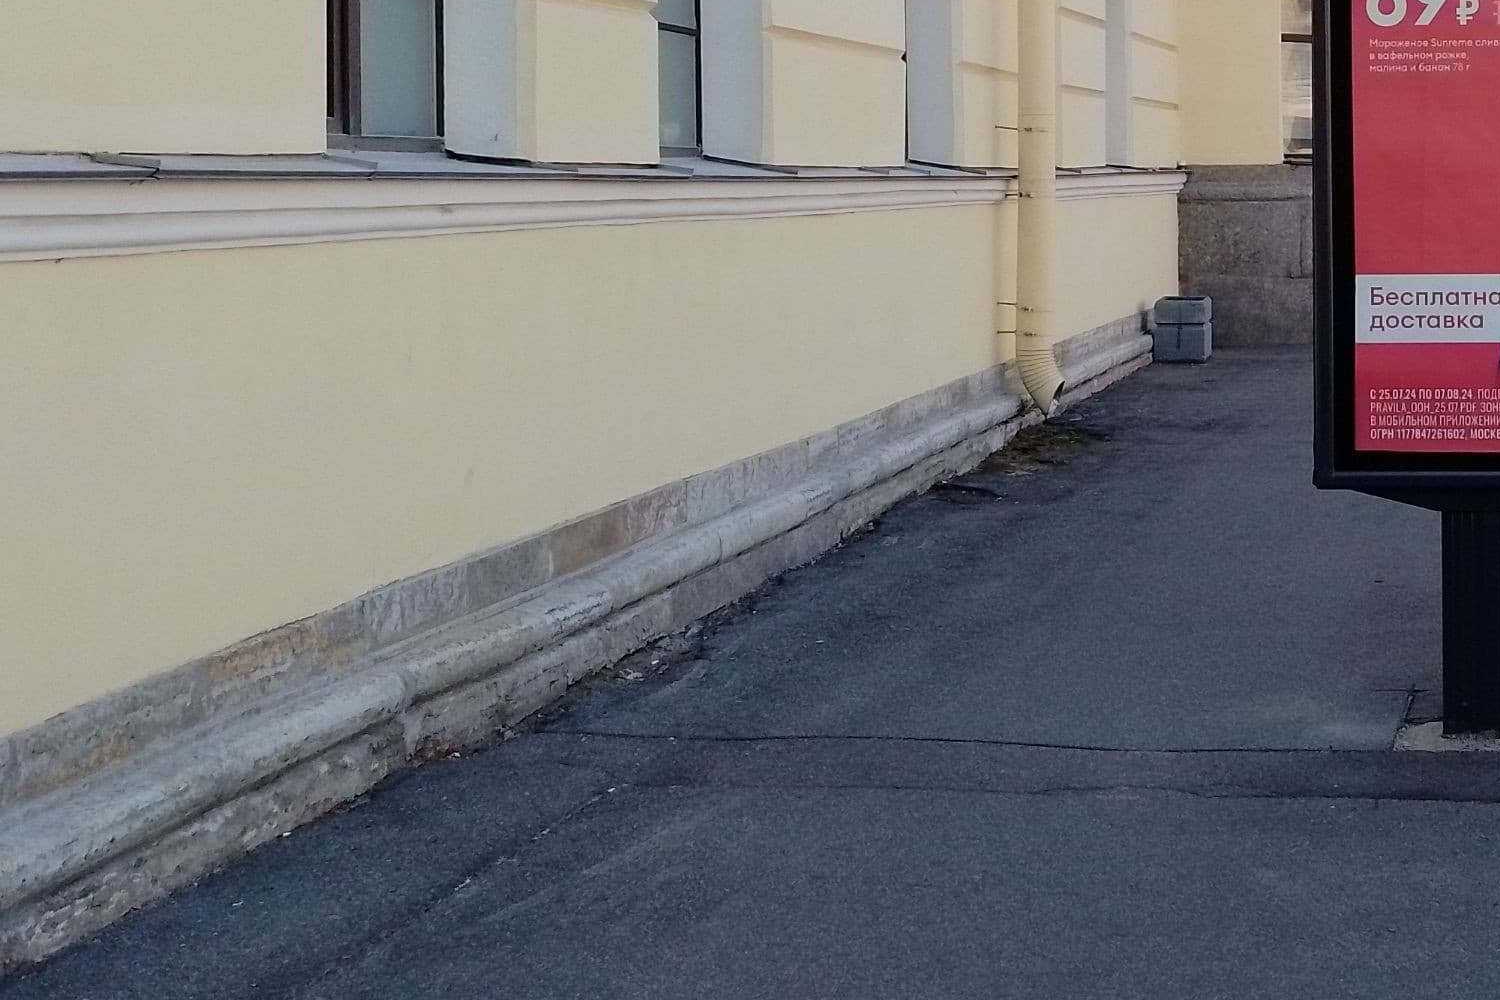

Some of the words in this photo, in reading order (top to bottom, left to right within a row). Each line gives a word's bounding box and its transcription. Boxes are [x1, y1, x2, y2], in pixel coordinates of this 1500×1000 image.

[1369, 38, 1428, 49] Мороженое
[1378, 51, 1433, 61] вафельном
[1419, 63, 1450, 72] банан
[1370, 314, 1484, 332] доставка
[1369, 388, 1377, 400] С
[1379, 388, 1417, 400] 25.07.24
[1419, 388, 1432, 400] ПО
[1370, 414, 1377, 426] В
[1379, 414, 1438, 426] МОБИЛЬНОМ
[1370, 428, 1394, 440] ОГРН
